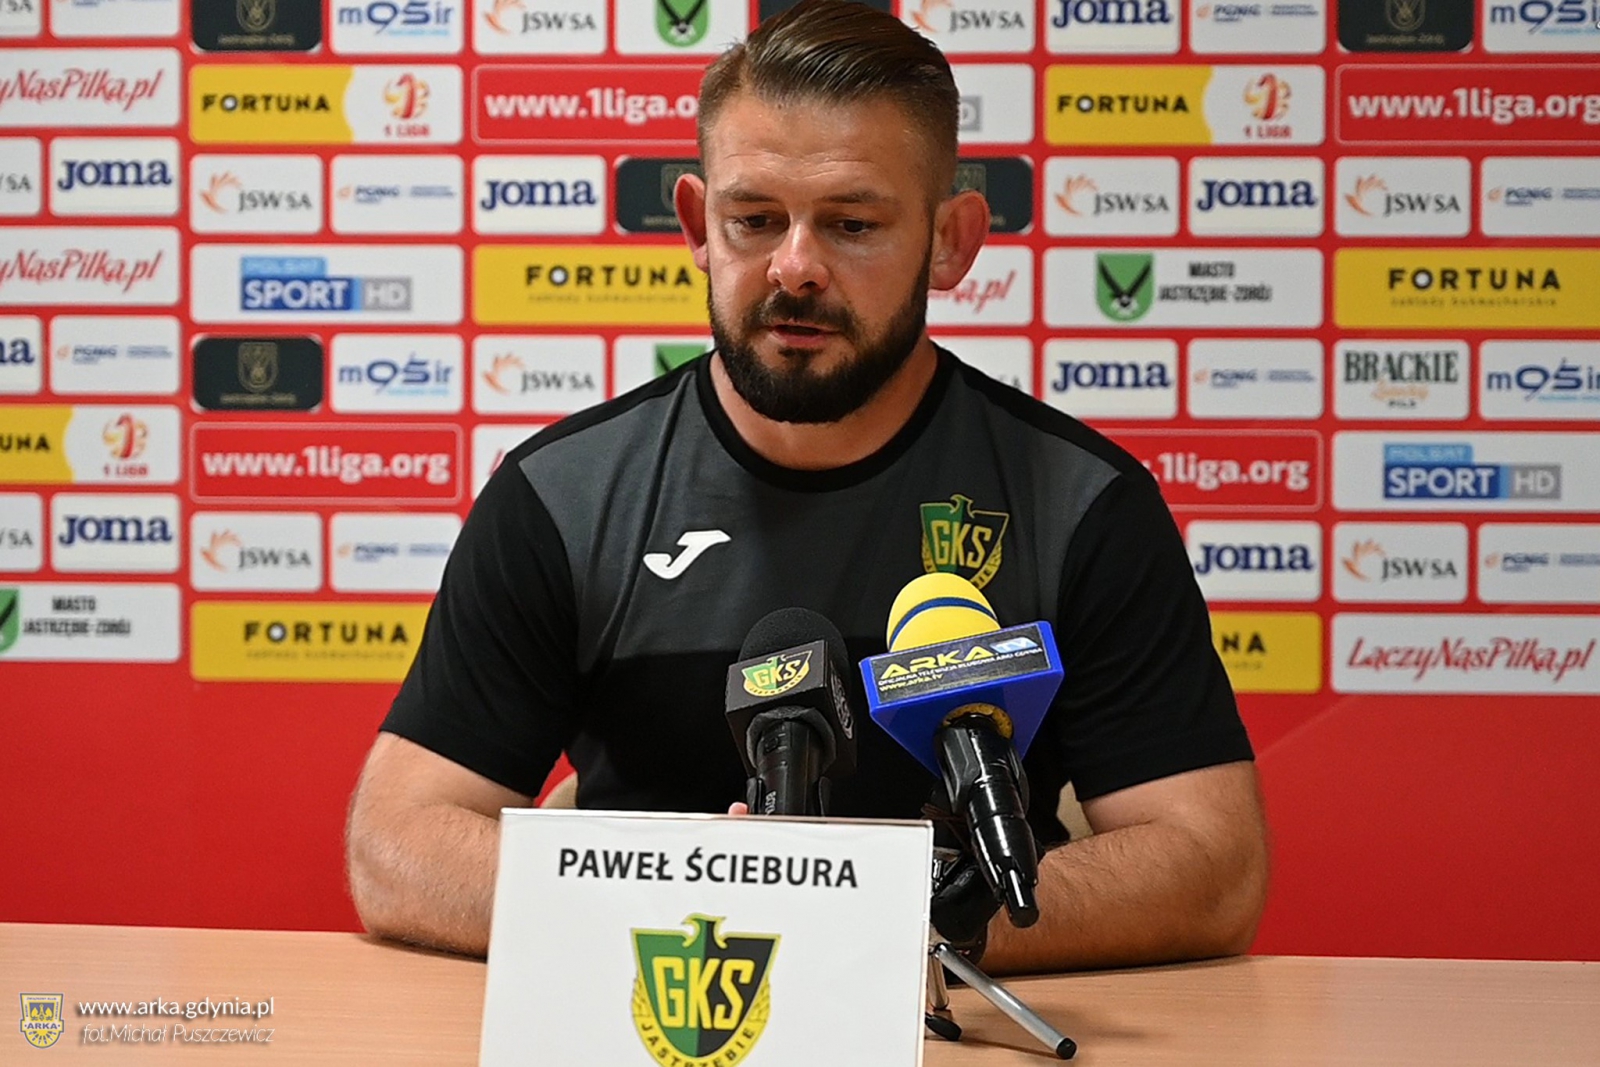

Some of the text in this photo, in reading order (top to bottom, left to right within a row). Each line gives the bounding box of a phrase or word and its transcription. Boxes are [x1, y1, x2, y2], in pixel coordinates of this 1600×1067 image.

[202, 95, 331, 112] FORTUNA
[1057, 95, 1190, 113] FORTUNA
[526, 266, 693, 286] FORTUNA
[1389, 269, 1560, 290] FORTUNA
[245, 279, 407, 308] SPORT HD
[1344, 351, 1459, 383] BRACKIE
[203, 447, 450, 483] www.1liga.org
[1388, 467, 1555, 496] SPORT HD
[930, 519, 992, 569] GKS
[244, 622, 409, 644] FORTUNA
[752, 659, 801, 688] GKS
[880, 646, 995, 680] ARKA
[558, 847, 859, 888] PAWEŁ ŚCIEBURA
[652, 956, 756, 1030] GKS
